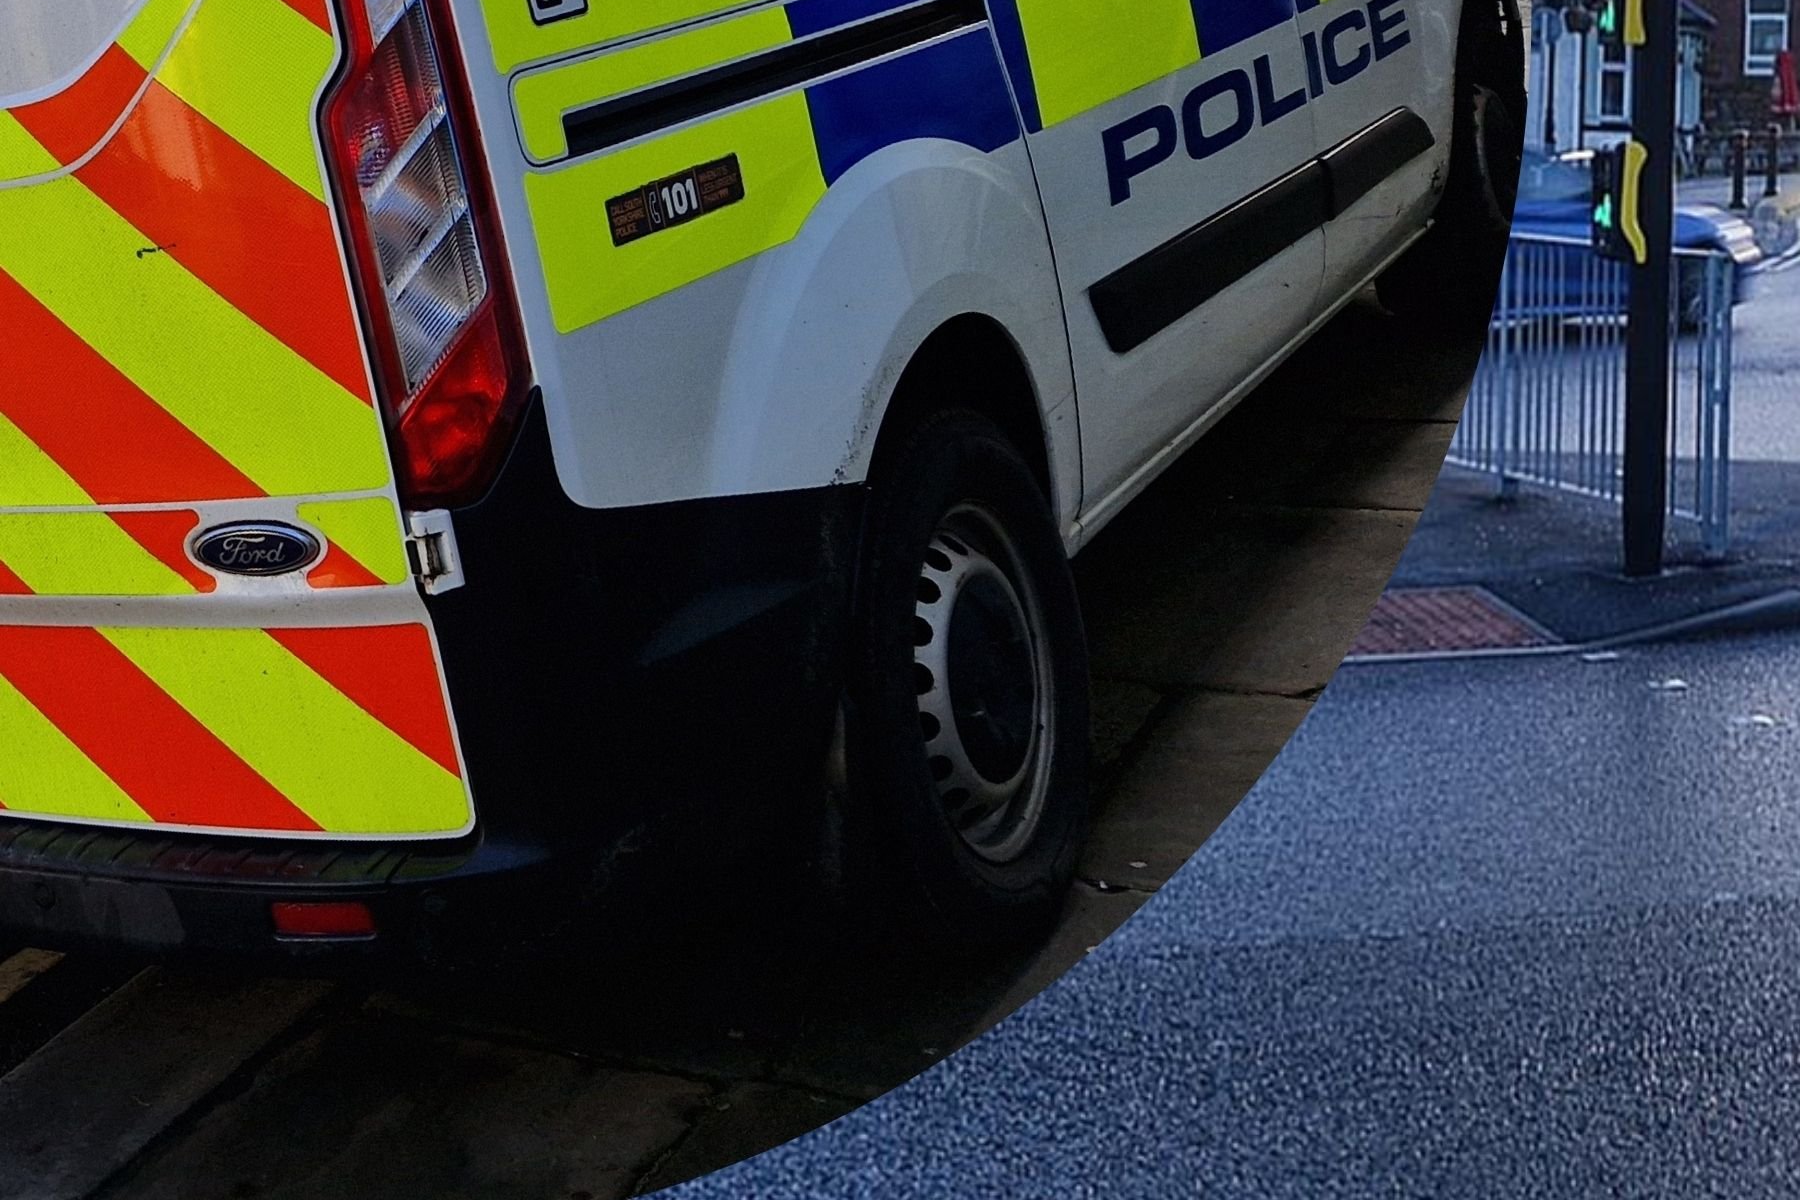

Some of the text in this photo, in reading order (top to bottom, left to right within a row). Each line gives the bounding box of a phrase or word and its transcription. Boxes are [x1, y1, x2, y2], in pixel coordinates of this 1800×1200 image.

[661, 178, 698, 219] 101
[615, 222, 639, 238] POLICE
[219, 536, 286, 565] Ford
